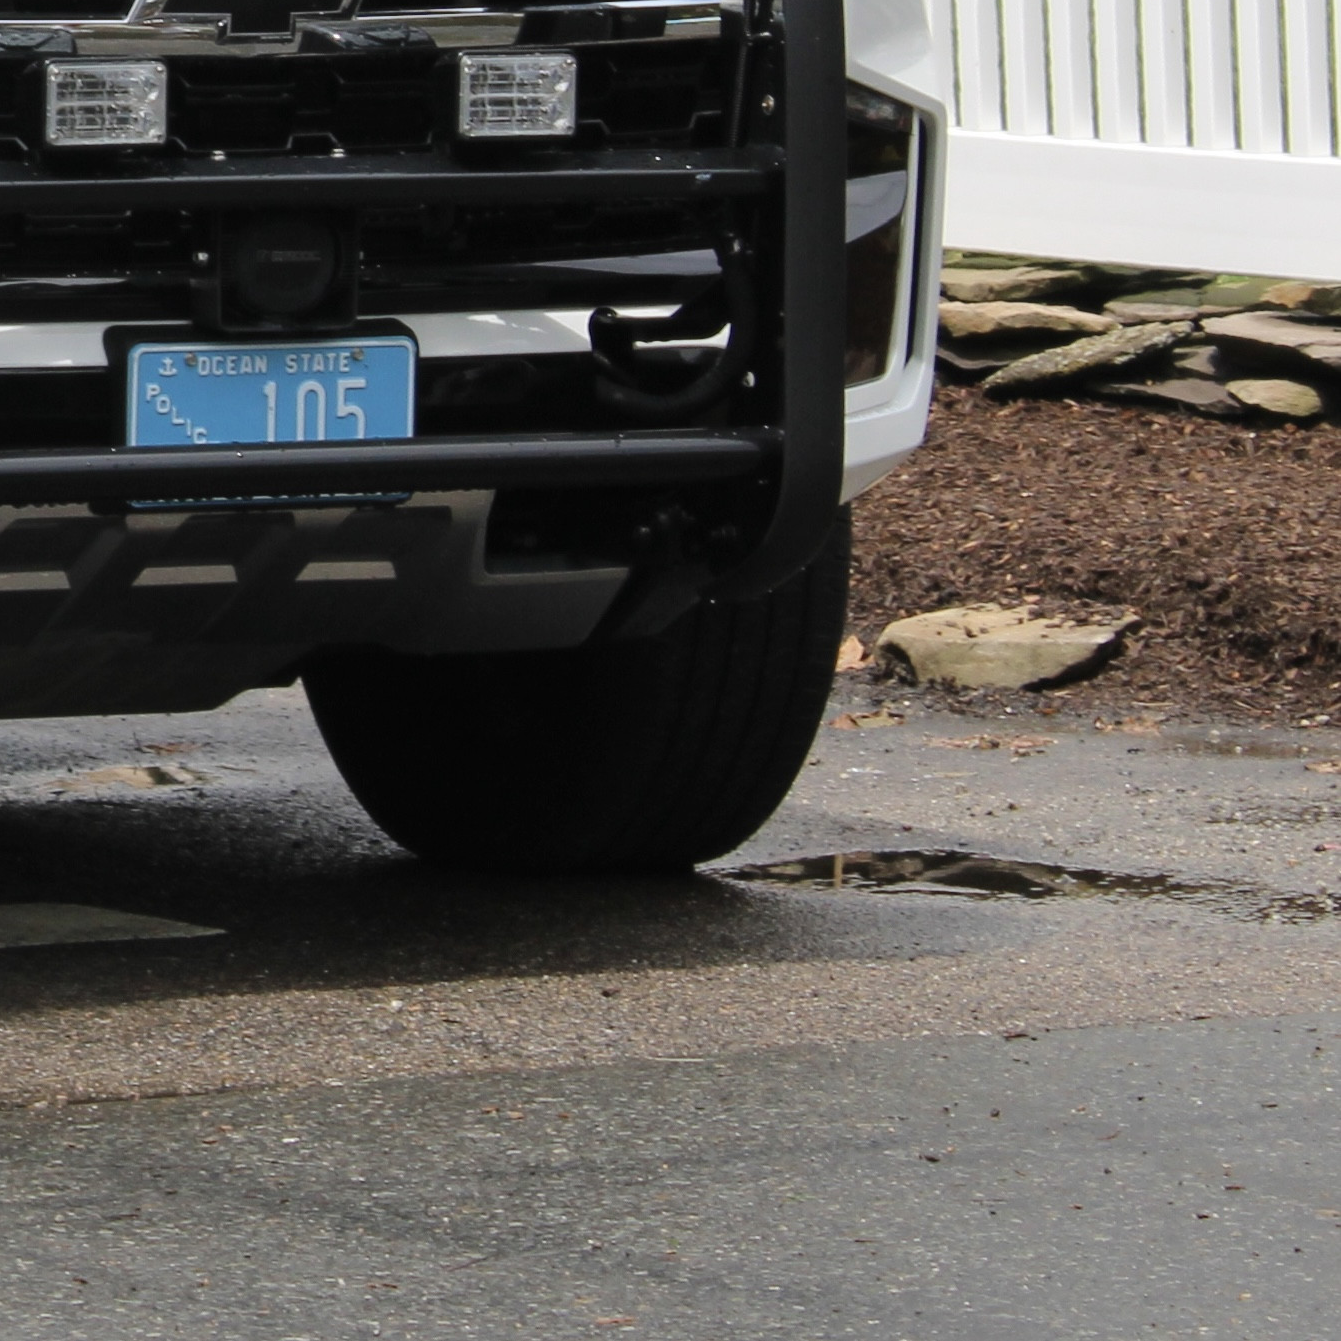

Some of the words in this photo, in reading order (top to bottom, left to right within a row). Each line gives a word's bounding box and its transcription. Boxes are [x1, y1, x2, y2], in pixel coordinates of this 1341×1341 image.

[196, 354, 267, 377] OCEAN
[284, 351, 352, 375] STATE
[145, 382, 208, 446] POLIC
[263, 377, 367, 443] 105
